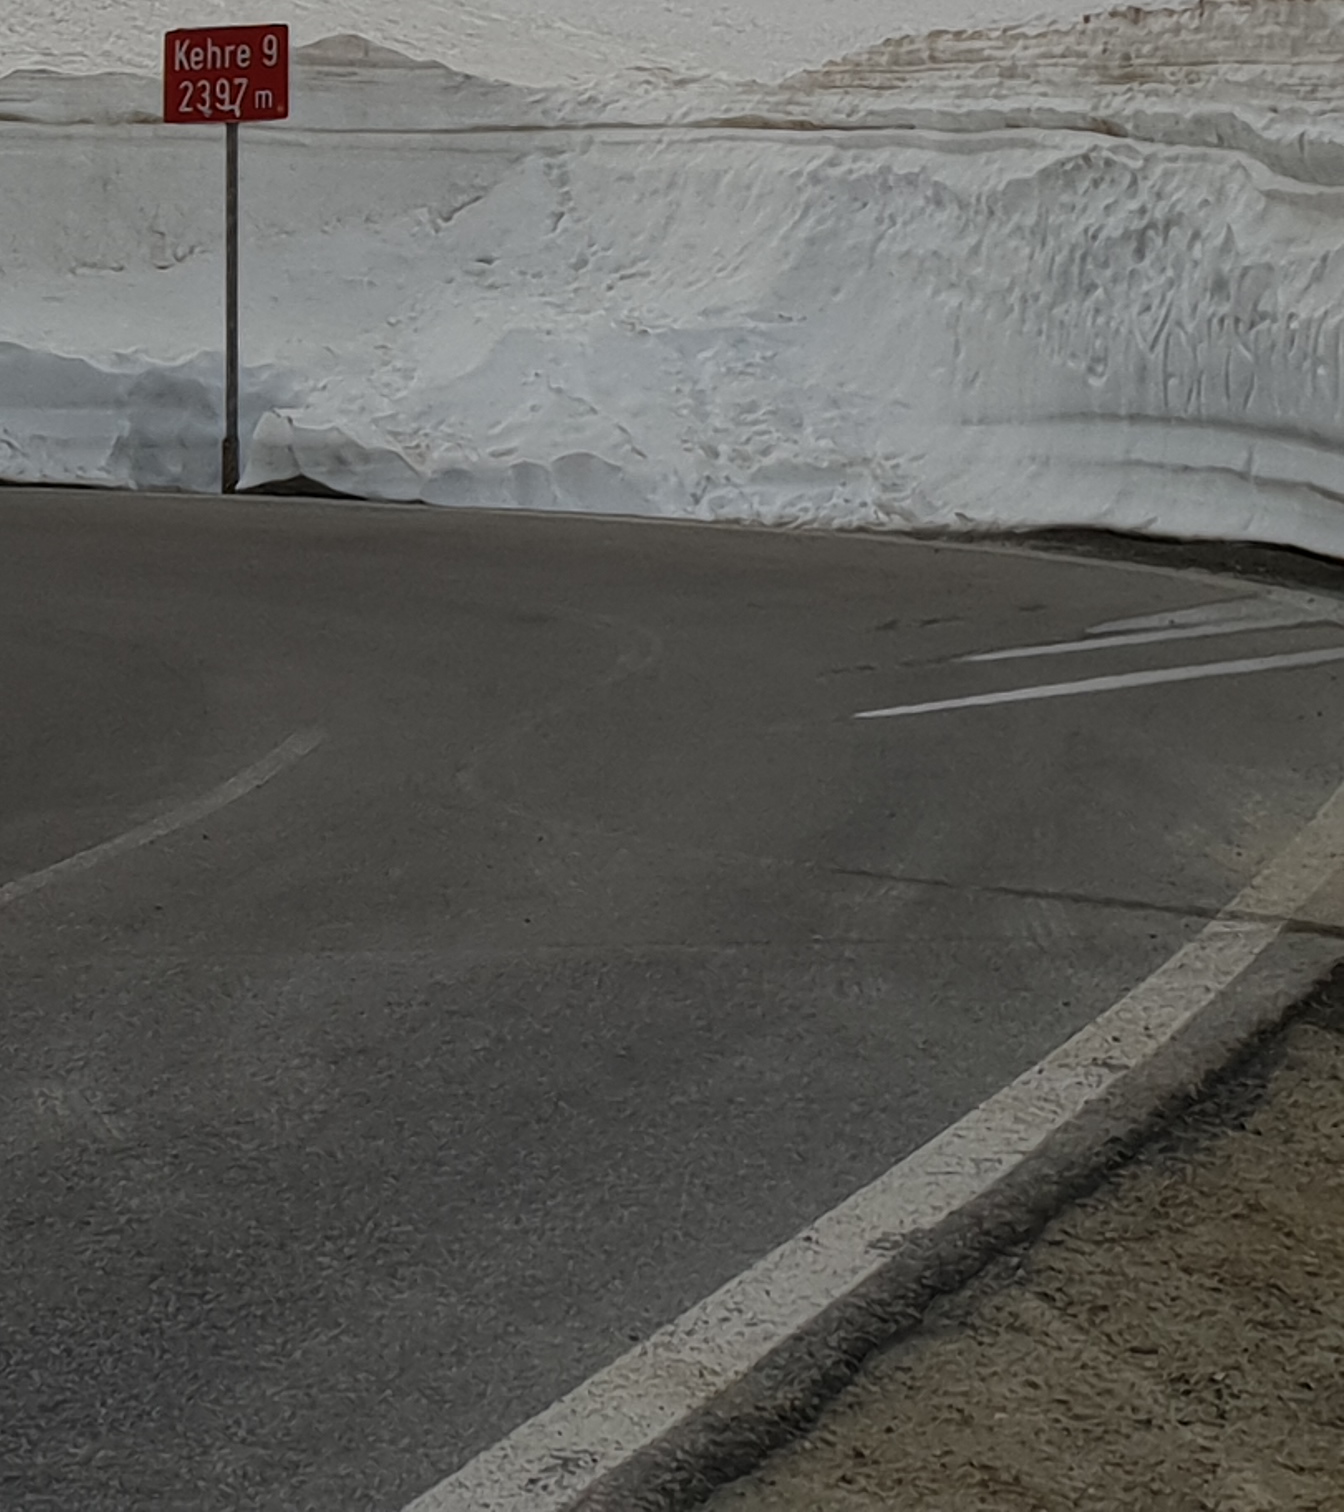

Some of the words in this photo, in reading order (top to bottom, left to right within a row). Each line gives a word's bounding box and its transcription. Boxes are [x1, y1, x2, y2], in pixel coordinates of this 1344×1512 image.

[174, 37, 251, 71] Kehre
[262, 34, 278, 67] 9
[178, 77, 249, 114] 2397
[254, 89, 273, 109] m
